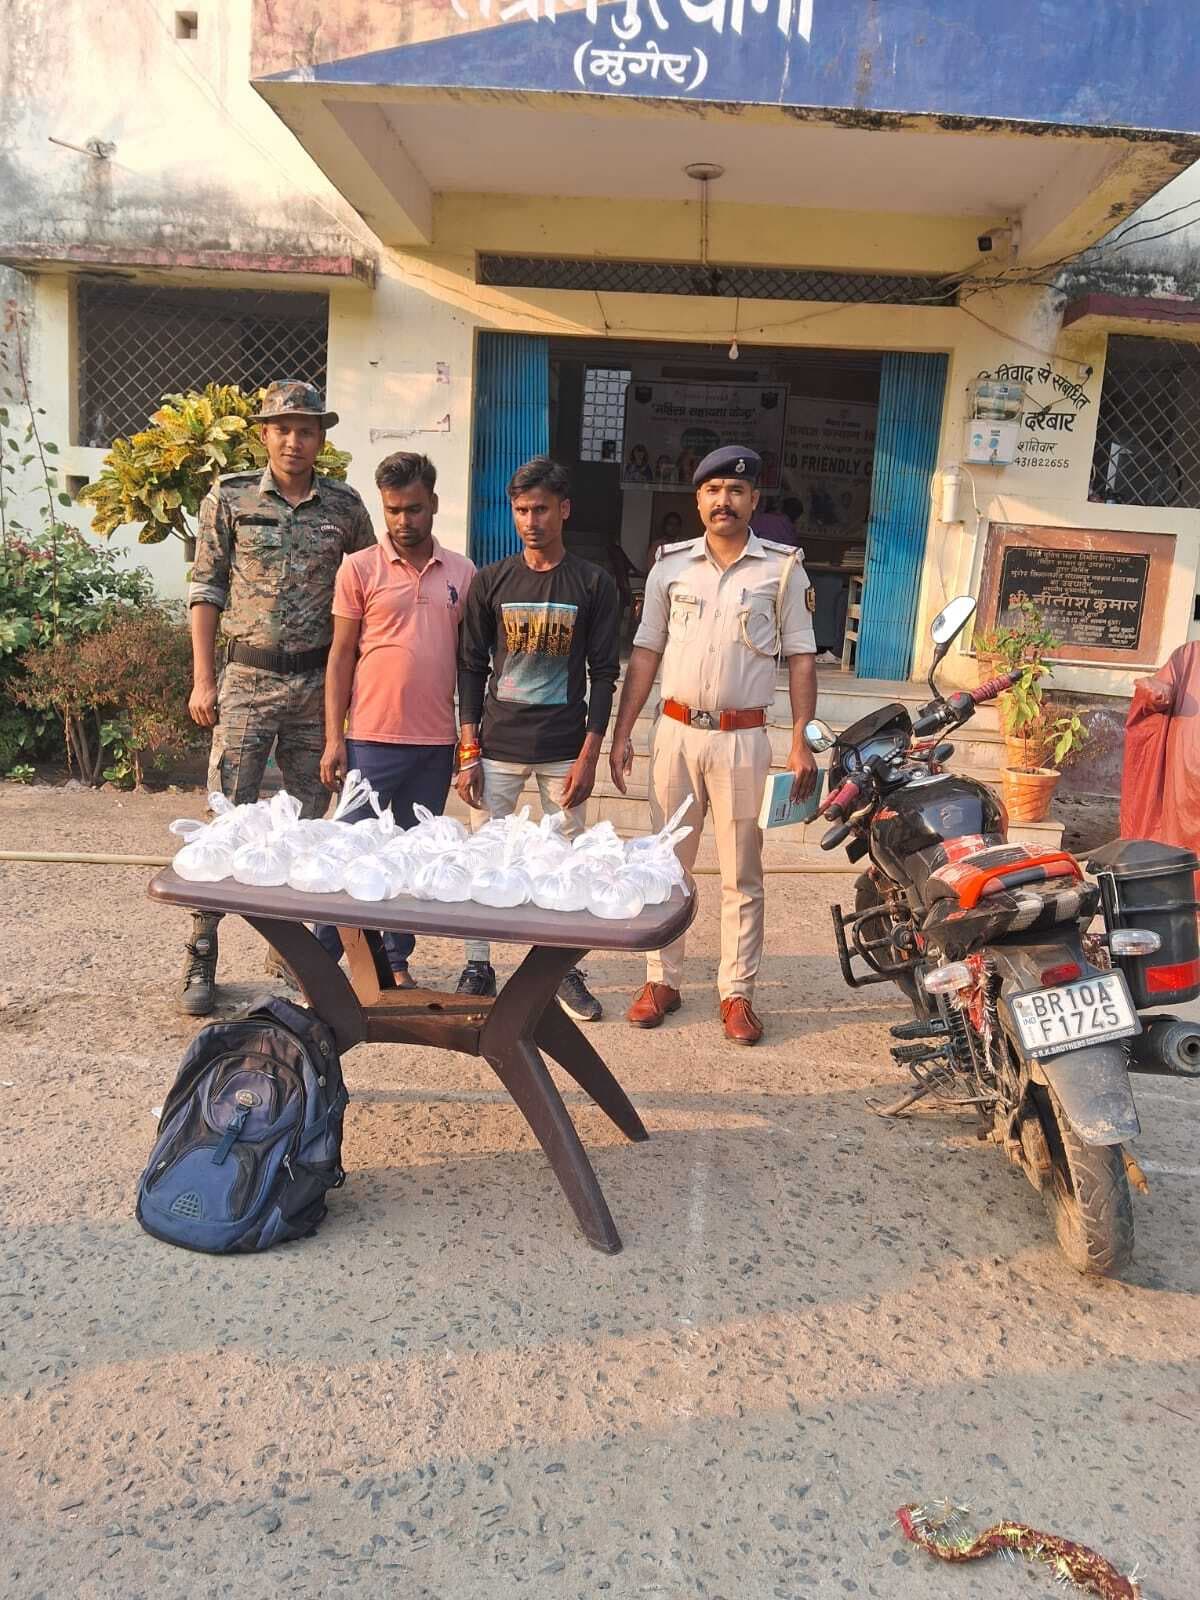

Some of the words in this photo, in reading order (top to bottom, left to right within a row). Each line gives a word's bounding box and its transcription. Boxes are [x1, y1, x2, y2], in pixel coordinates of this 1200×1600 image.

[573, 39, 709, 91] (मुंगेर)
[1025, 412, 1077, 432] दरबार
[801, 455, 861, 476] FRIENDLY
[1093, 598, 1139, 614] कुमार
[1032, 981, 1112, 1018] BR10A
[1040, 1004, 1118, 1042] F1745
